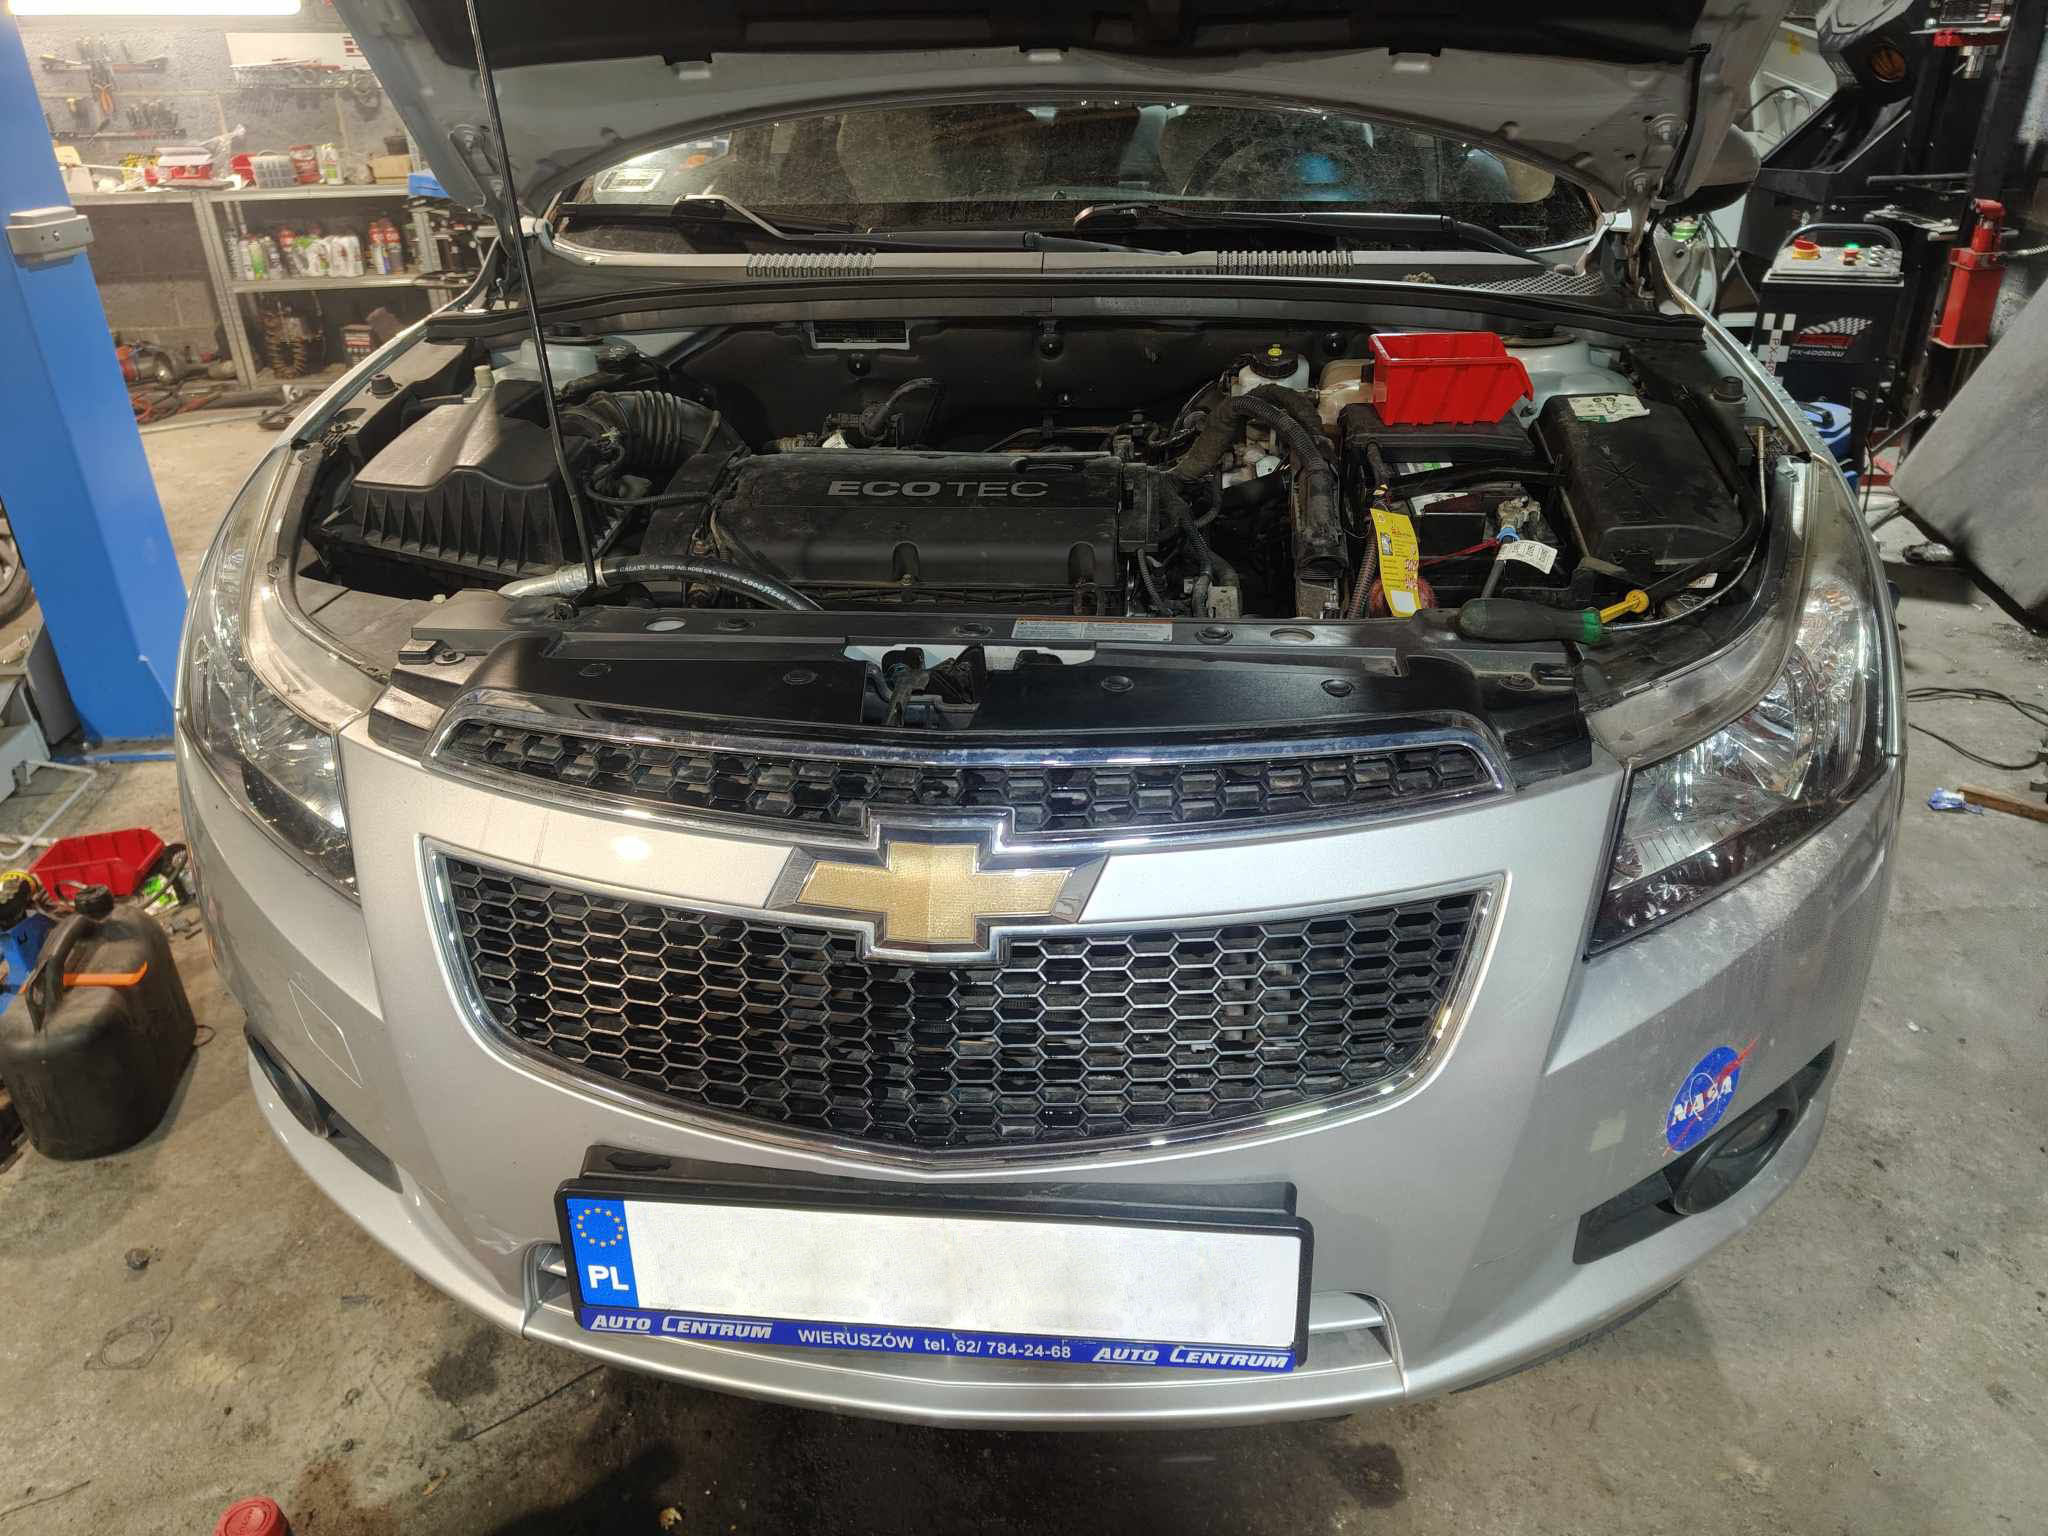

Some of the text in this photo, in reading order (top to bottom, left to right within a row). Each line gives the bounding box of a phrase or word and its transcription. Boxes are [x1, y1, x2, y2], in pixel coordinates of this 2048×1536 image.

[1765, 337, 1781, 376] PX-40
[827, 480, 1049, 497] ECOTEC
[1671, 1075, 1733, 1126] NASA
[587, 1264, 630, 1291] PL
[590, 1314, 1291, 1369] AUTO CENTRUM WIERUSZÓW tel. 62/ 784-24-68 AUTO CENTRUM
